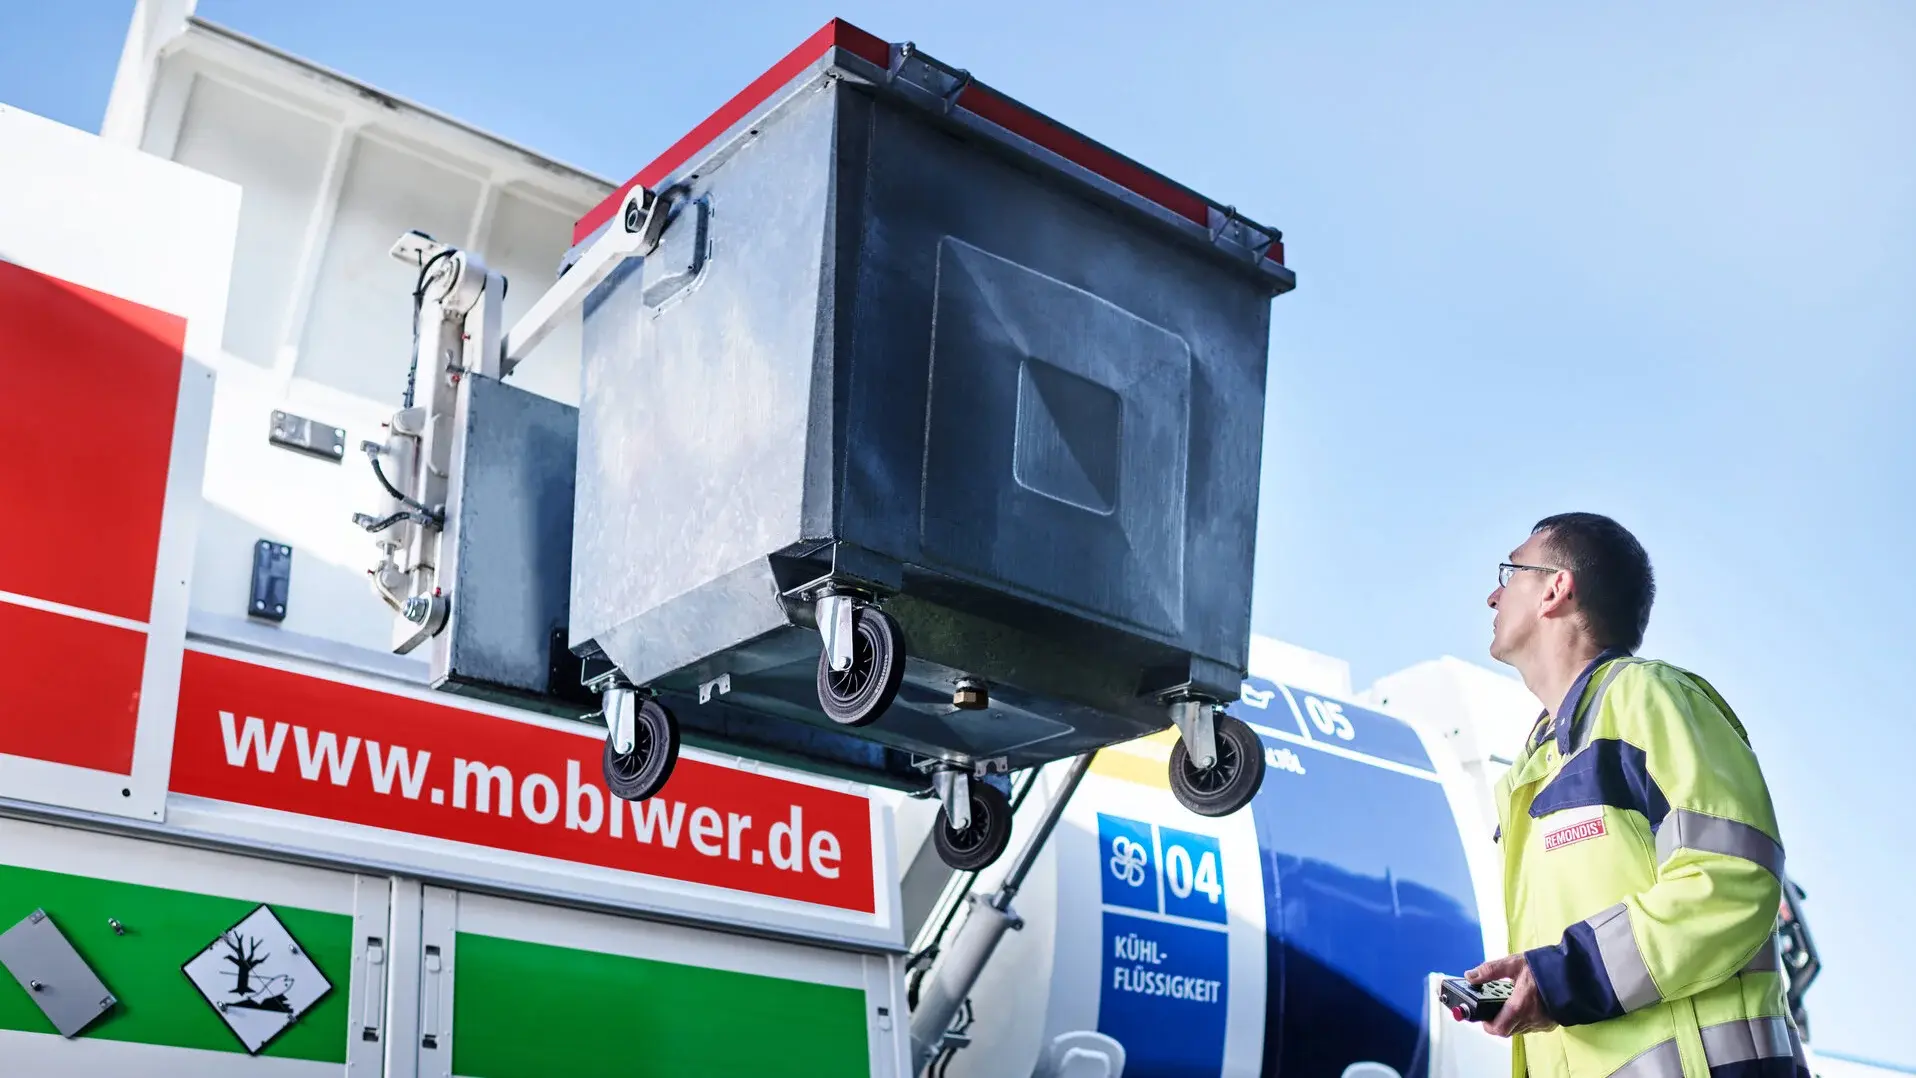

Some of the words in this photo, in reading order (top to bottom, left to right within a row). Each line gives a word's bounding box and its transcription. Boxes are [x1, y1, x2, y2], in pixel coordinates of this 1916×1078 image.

[1304, 695, 1355, 740] 05
[1165, 845, 1222, 904] 04
[1114, 934, 1167, 964] KÜHL-
[1113, 967, 1221, 1003] FLÜSSIGKEIT
